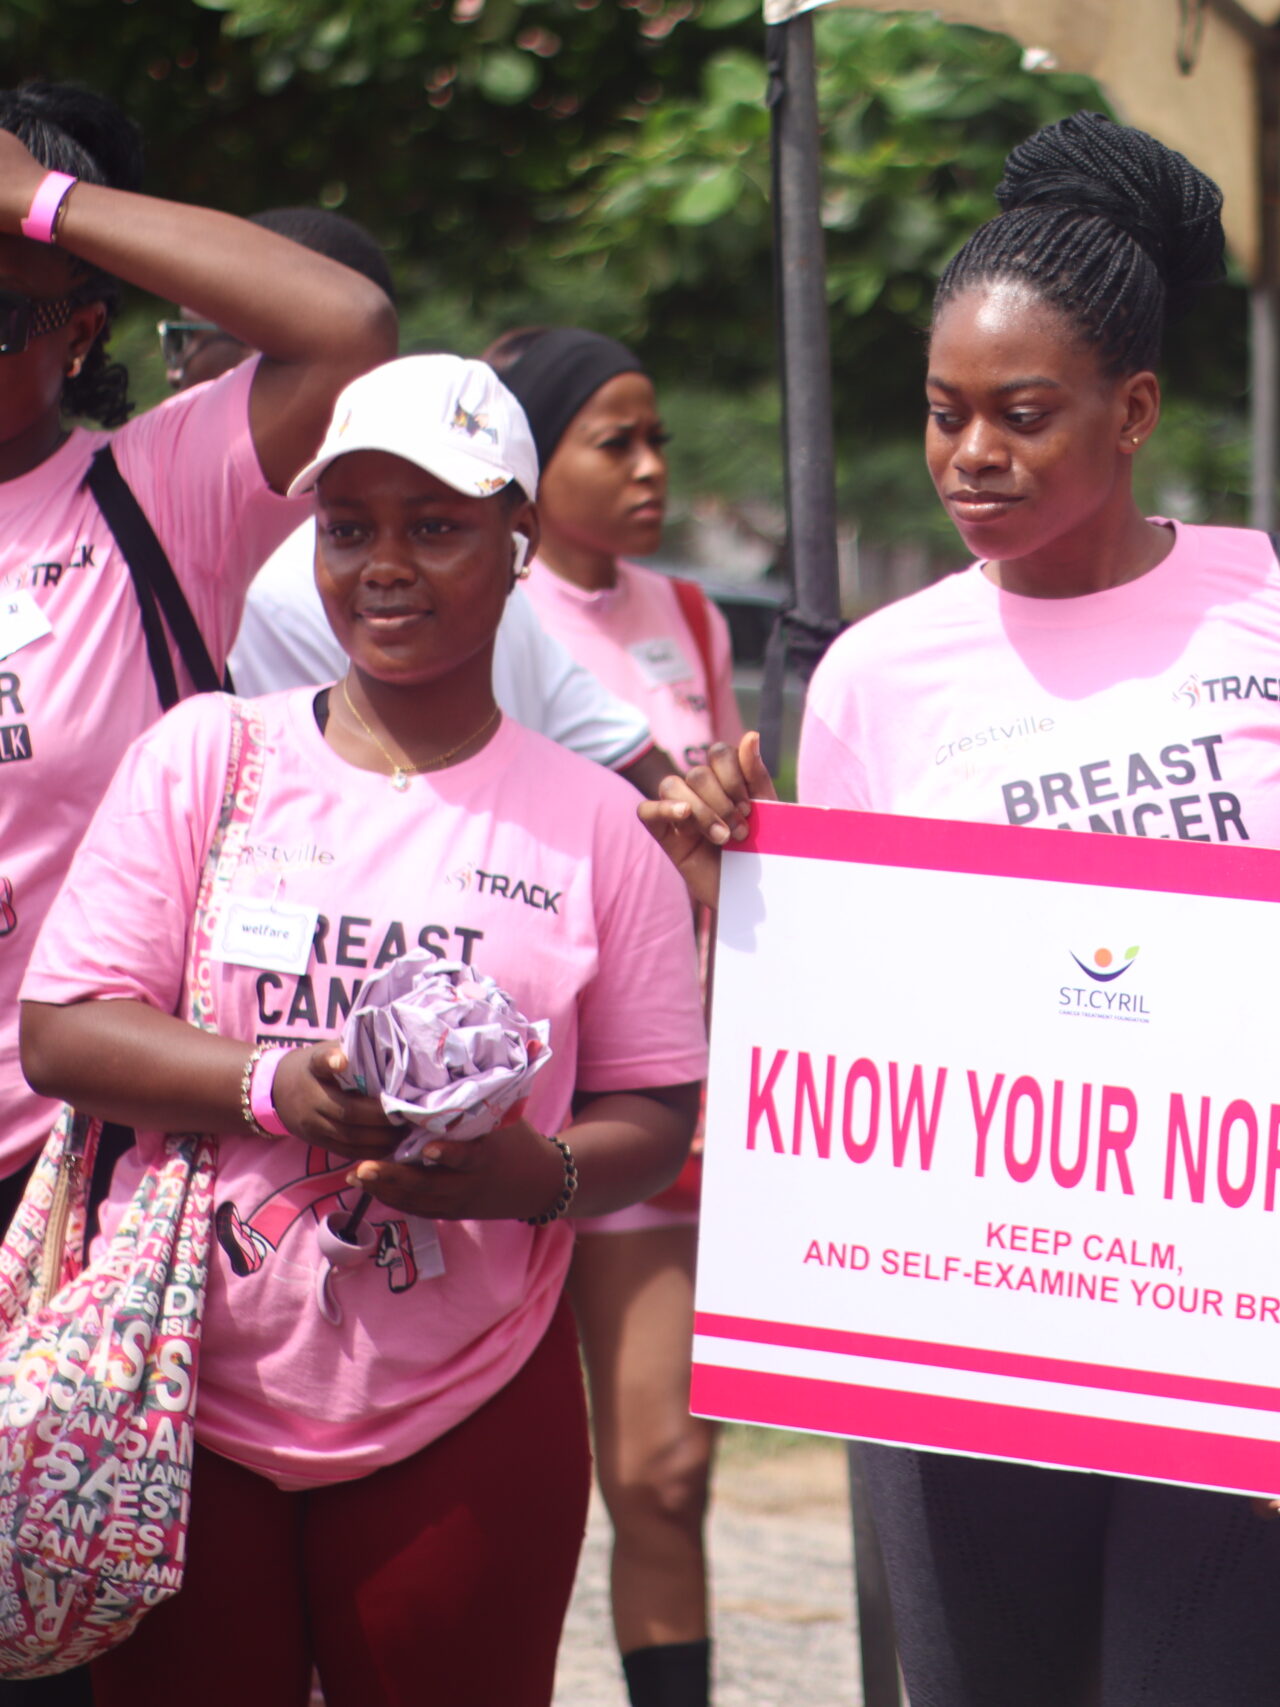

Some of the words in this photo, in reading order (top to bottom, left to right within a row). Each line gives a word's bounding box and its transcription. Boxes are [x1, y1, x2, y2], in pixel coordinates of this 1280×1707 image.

[934, 715, 1056, 766] crestville
[1001, 734, 1223, 826] BREAST
[1058, 791, 1250, 843] NCER
[476, 869, 562, 914] TRACK
[241, 923, 290, 940] welfare
[313, 913, 484, 969] REAST
[1059, 986, 1150, 1014] ST.CYRIL
[746, 1046, 948, 1171] KNOW
[966, 1069, 1138, 1196] YOUR
[986, 1222, 1073, 1256] KEEP
[1083, 1234, 1184, 1277] CALM,
[803, 1240, 870, 1271] AND
[881, 1249, 1120, 1304] SELF-EXAMINE
[1131, 1279, 1223, 1317] YOUR
